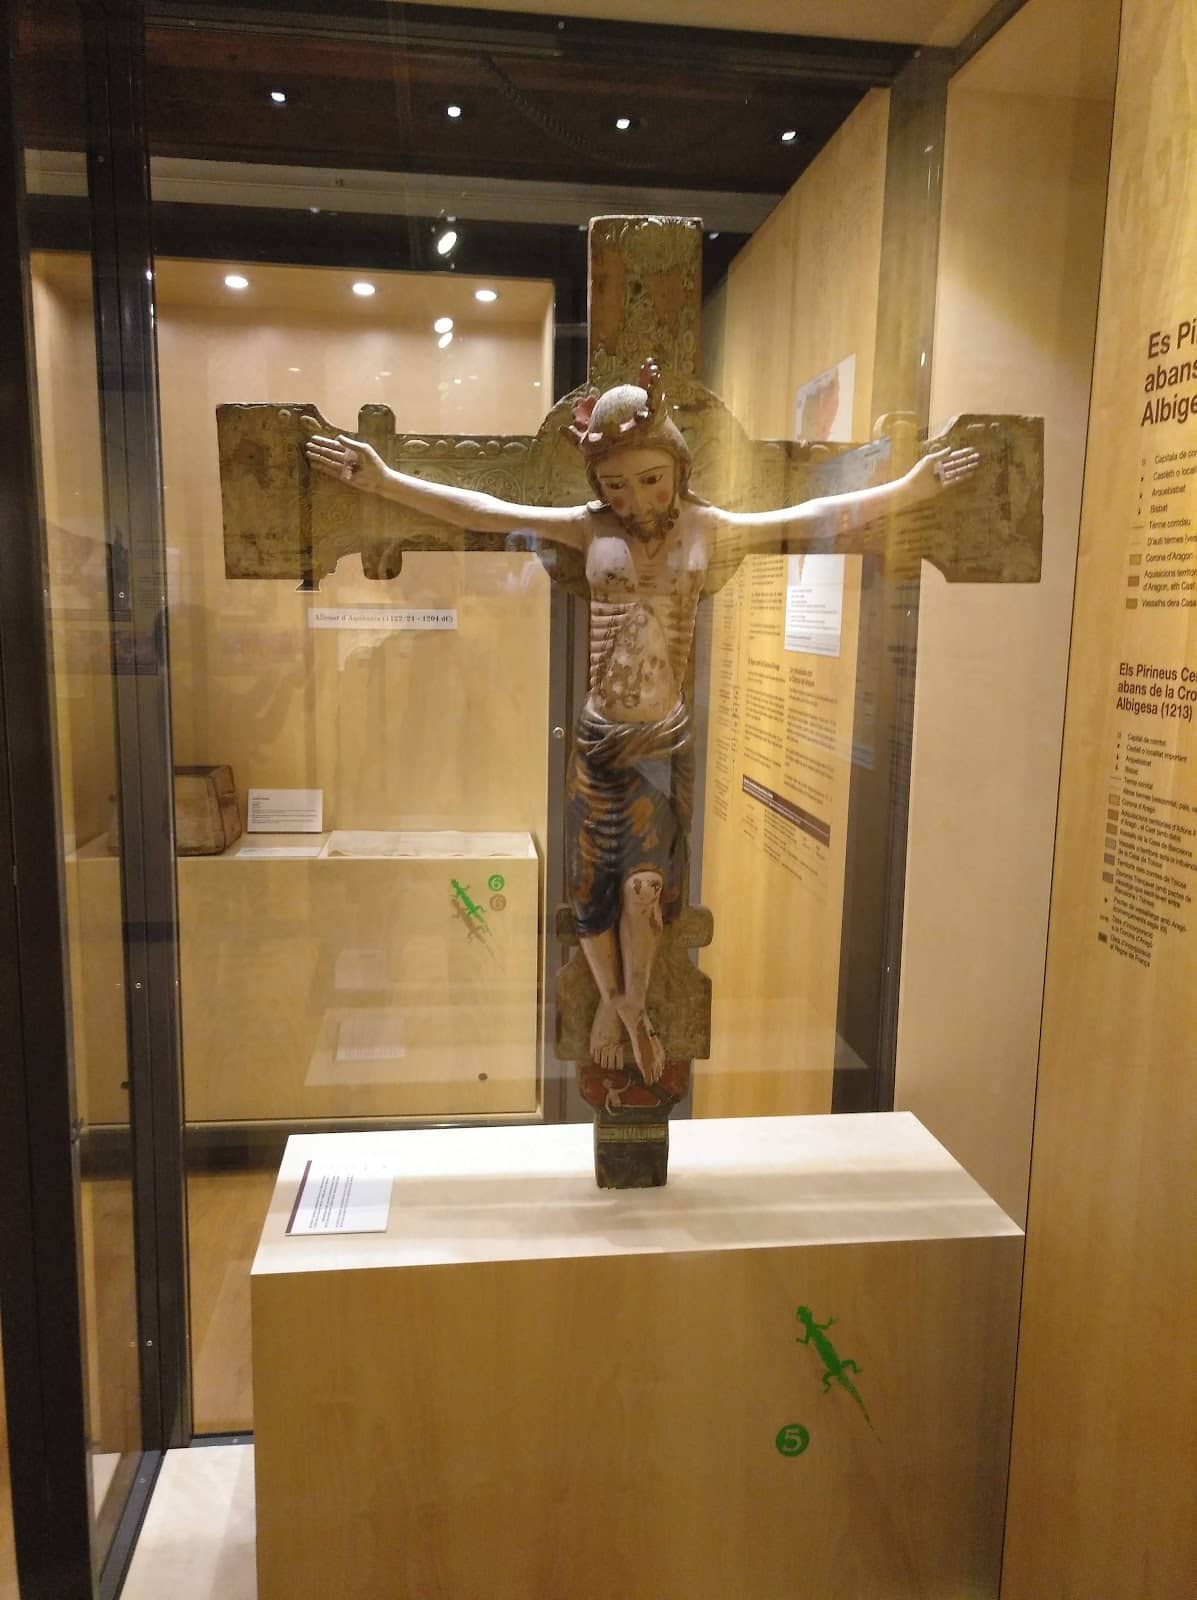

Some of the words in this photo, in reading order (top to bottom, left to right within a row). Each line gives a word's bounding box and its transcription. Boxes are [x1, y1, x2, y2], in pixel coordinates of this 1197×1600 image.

[1148, 331, 1170, 359] Es
[1177, 318, 1197, 350] Pi
[1119, 662, 1134, 677] Els
[1136, 664, 1178, 681] Pirineus
[1181, 667, 1197, 683] Ce
[1118, 680, 1147, 696] abans
[1149, 683, 1162, 697] de
[1165, 685, 1174, 699] la
[1116, 696, 1158, 715] Albigesa
[1160, 702, 1193, 723] (1213)
[784, 1429, 801, 1451] 5
